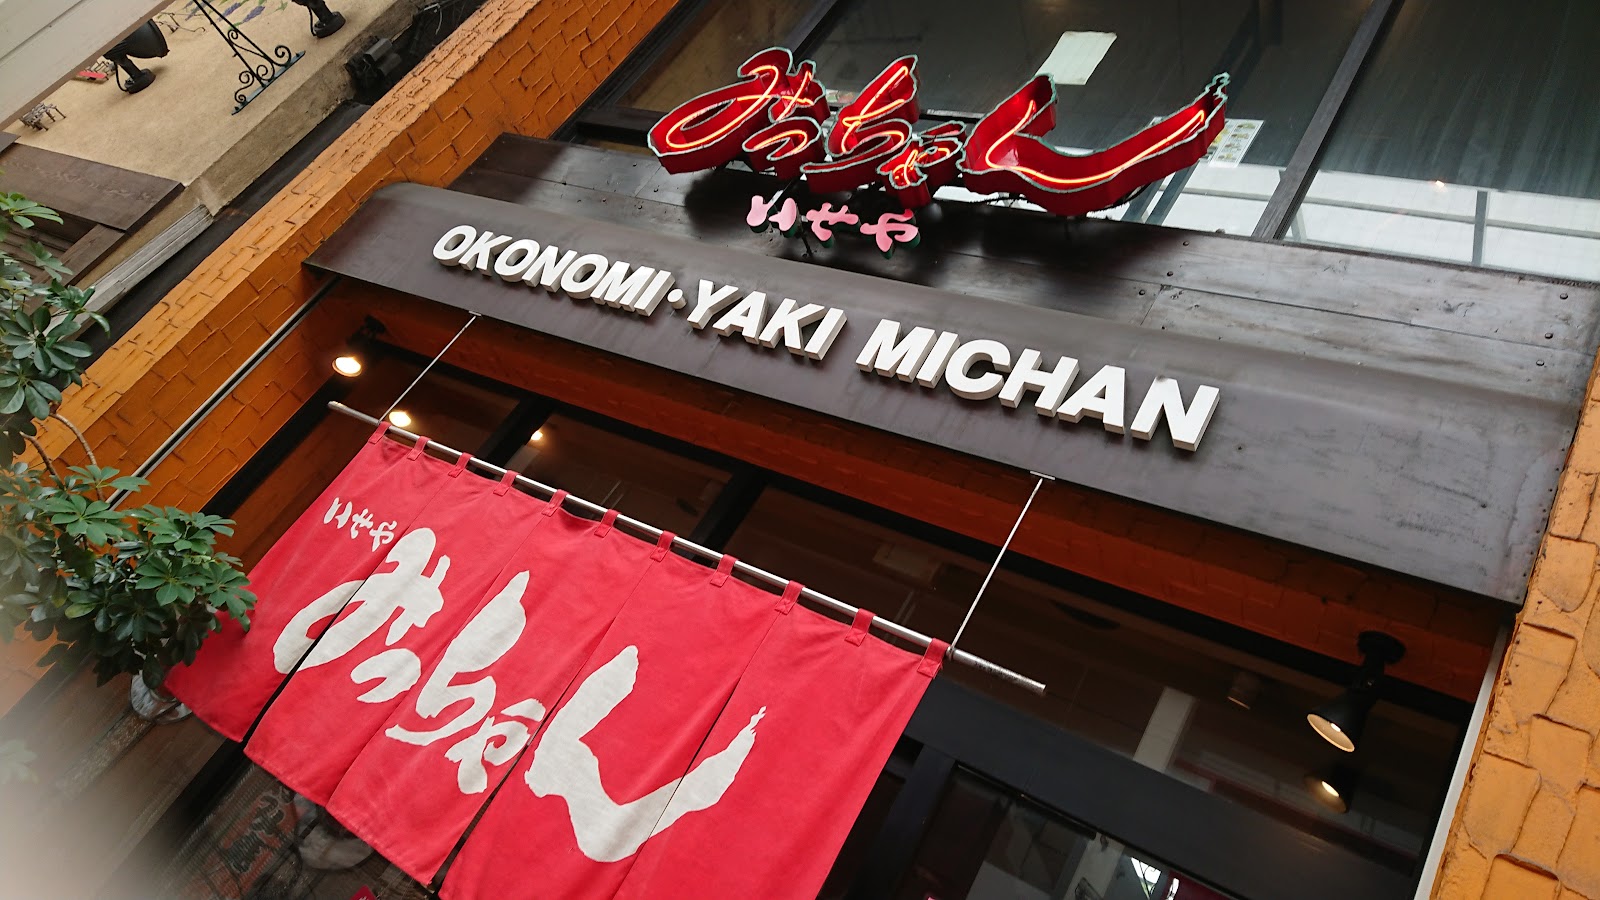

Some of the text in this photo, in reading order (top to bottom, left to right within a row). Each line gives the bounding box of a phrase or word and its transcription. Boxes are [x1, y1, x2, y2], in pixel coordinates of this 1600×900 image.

[647, 47, 1228, 214] みっちゃん
[746, 195, 920, 258] いせや
[856, 318, 1220, 452] MICHAN
[323, 497, 398, 552] いせや
[273, 528, 766, 862] みっちゃん
